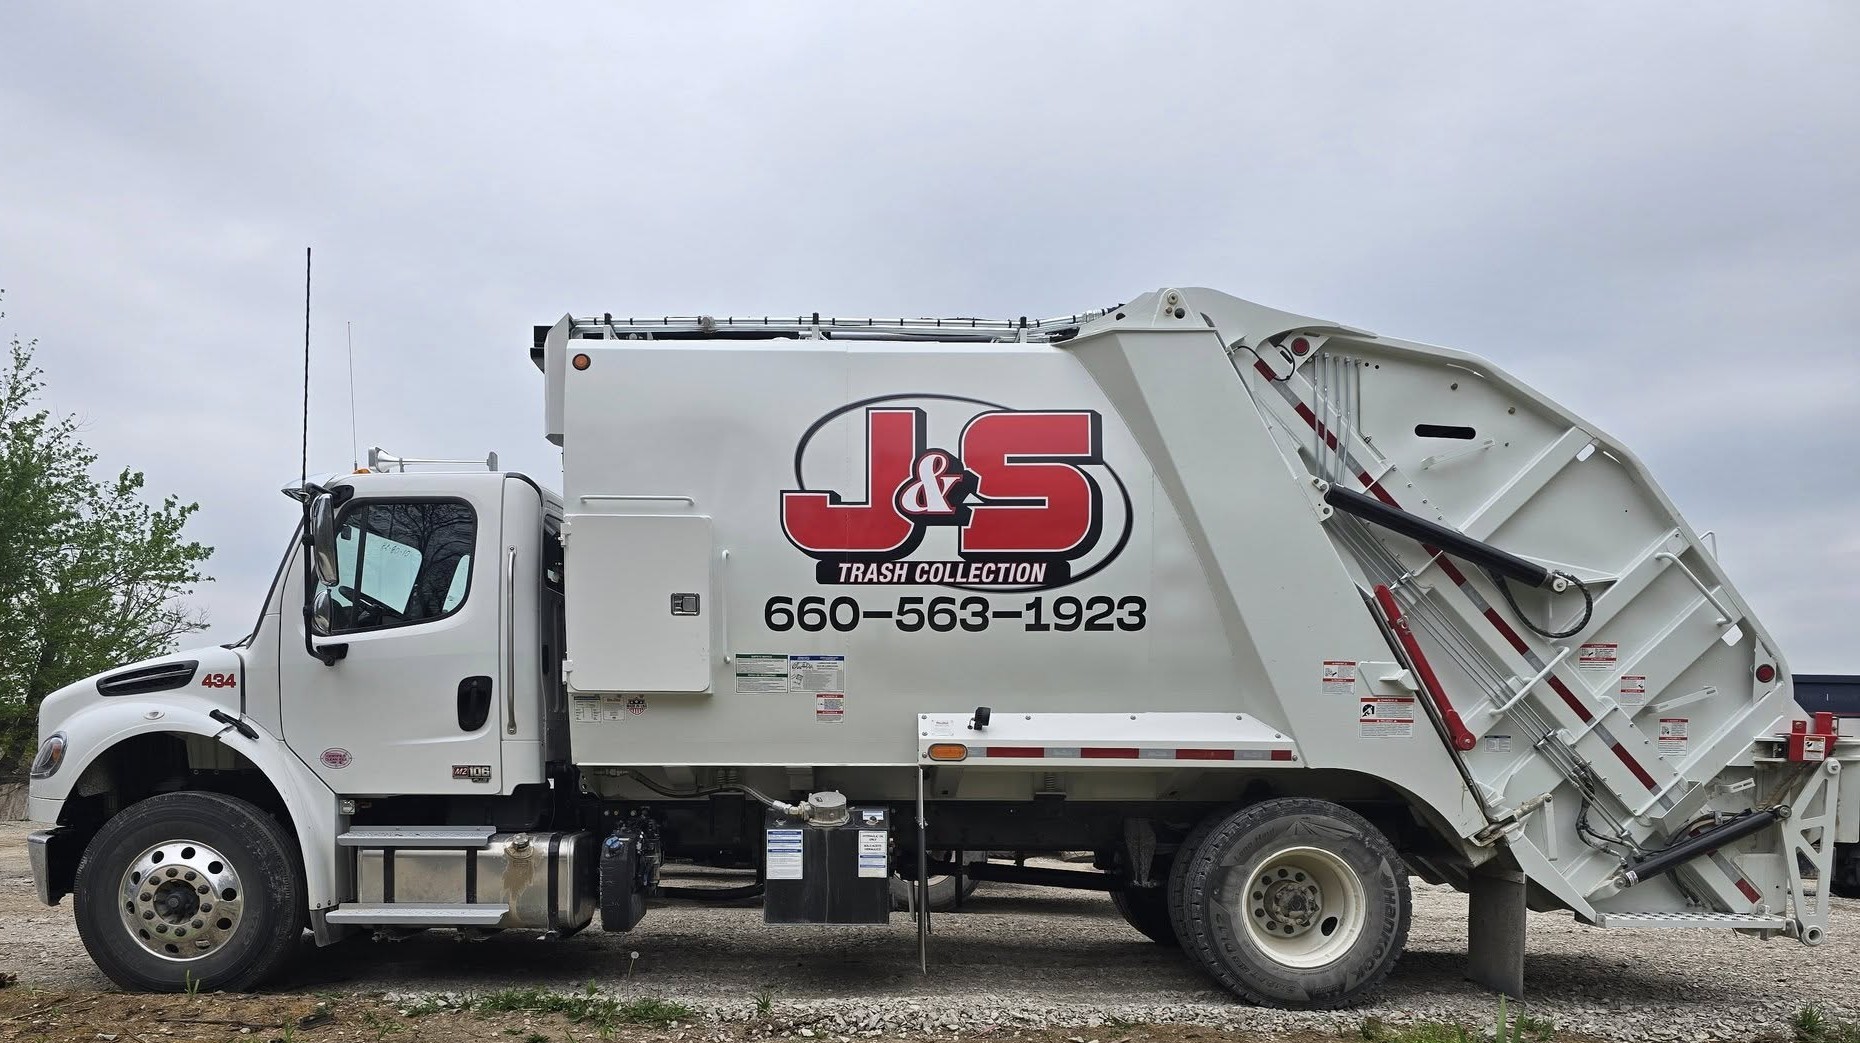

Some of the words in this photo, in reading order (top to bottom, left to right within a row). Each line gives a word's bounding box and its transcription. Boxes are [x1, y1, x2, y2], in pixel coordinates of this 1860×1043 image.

[780, 407, 1103, 558] J&S
[838, 562, 907, 584] TRASH
[914, 562, 1047, 584] COLLECTION
[764, 595, 1148, 632] 660-563-1923
[201, 673, 237, 689] 434
[454, 767, 468, 775] M2
[469, 766, 490, 777] 106
